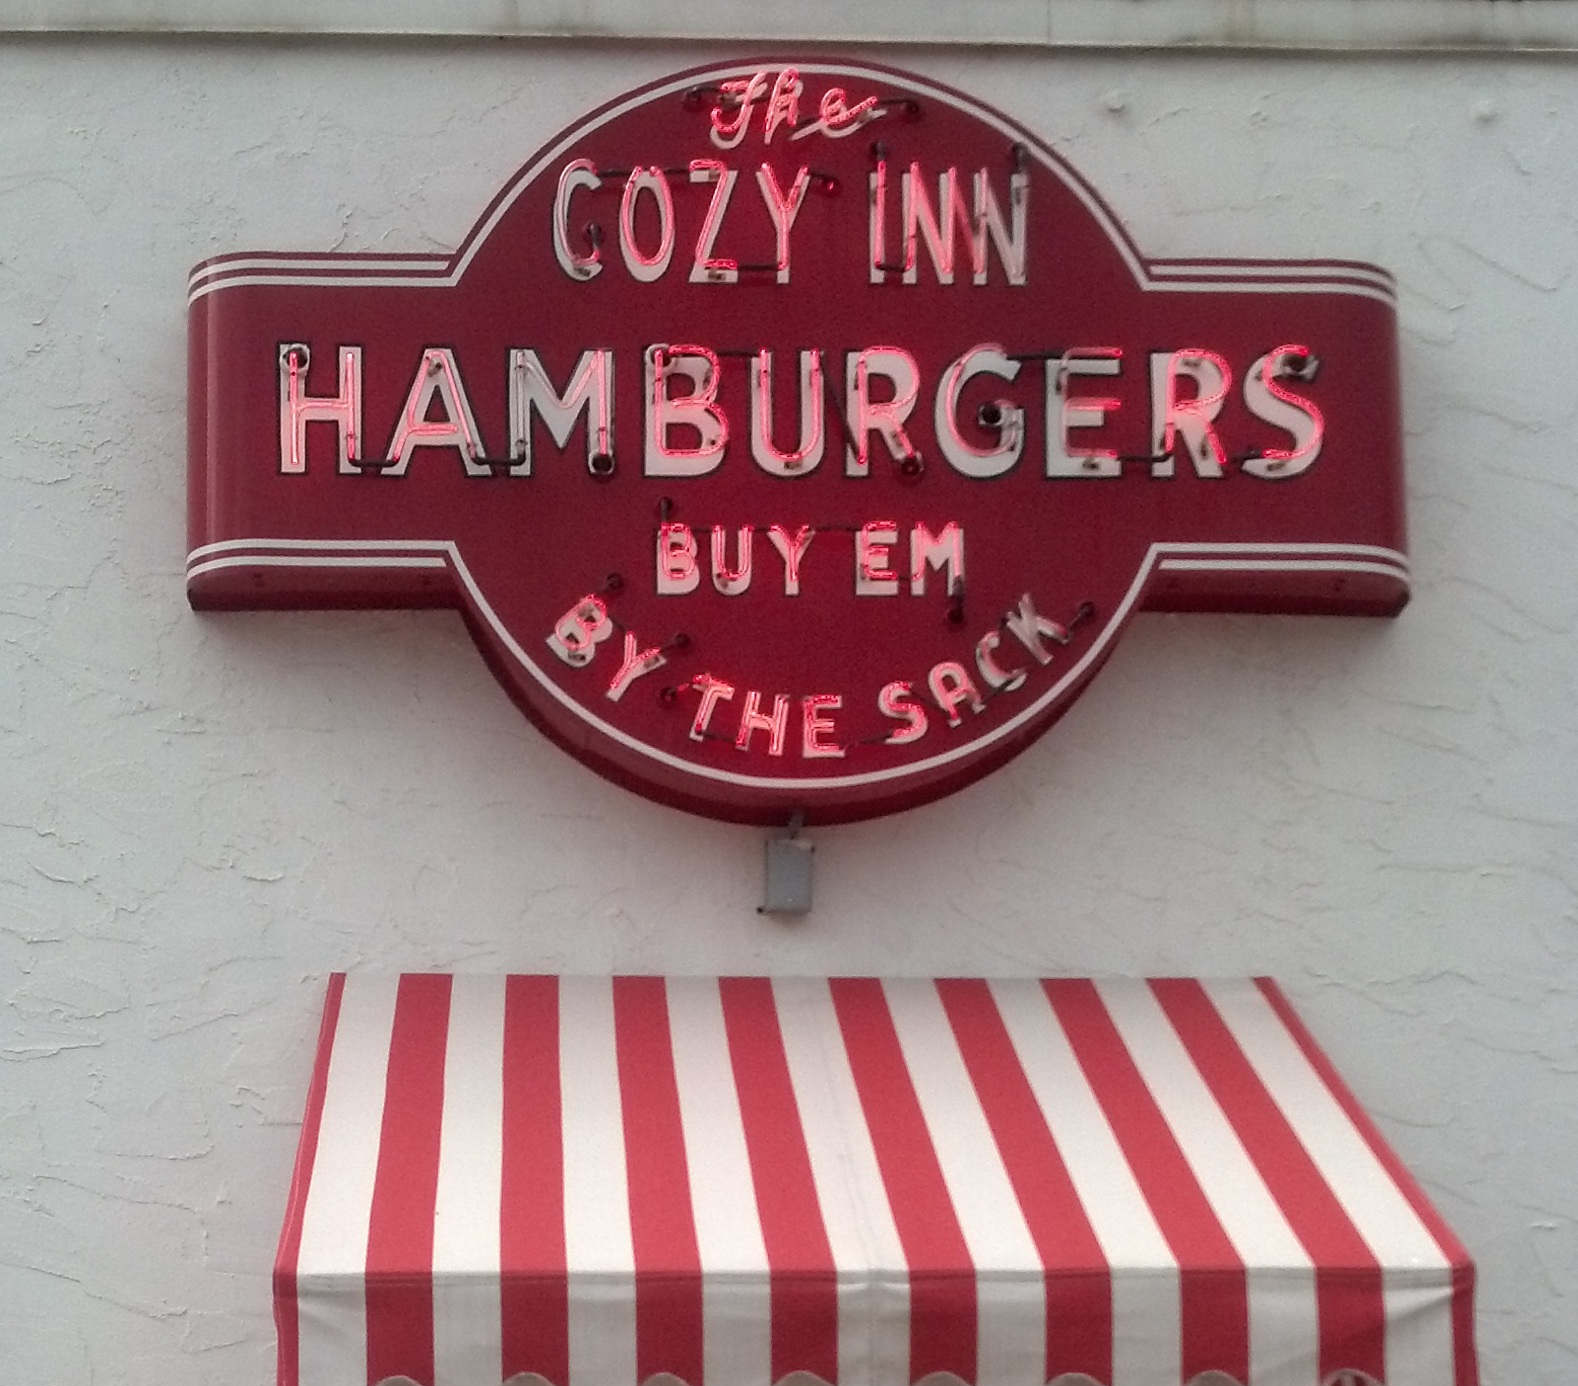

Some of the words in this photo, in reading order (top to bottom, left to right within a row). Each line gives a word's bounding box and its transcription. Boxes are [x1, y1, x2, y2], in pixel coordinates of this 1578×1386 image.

[709, 67, 888, 150] The
[553, 157, 812, 285] COZY
[869, 159, 1030, 285] INN
[279, 343, 1325, 479] HAMBURGERS
[656, 521, 817, 596] BUY
[854, 519, 965, 596] EM
[545, 593, 667, 702] BY
[690, 672, 846, 759] THE
[878, 592, 1070, 745] SACK
